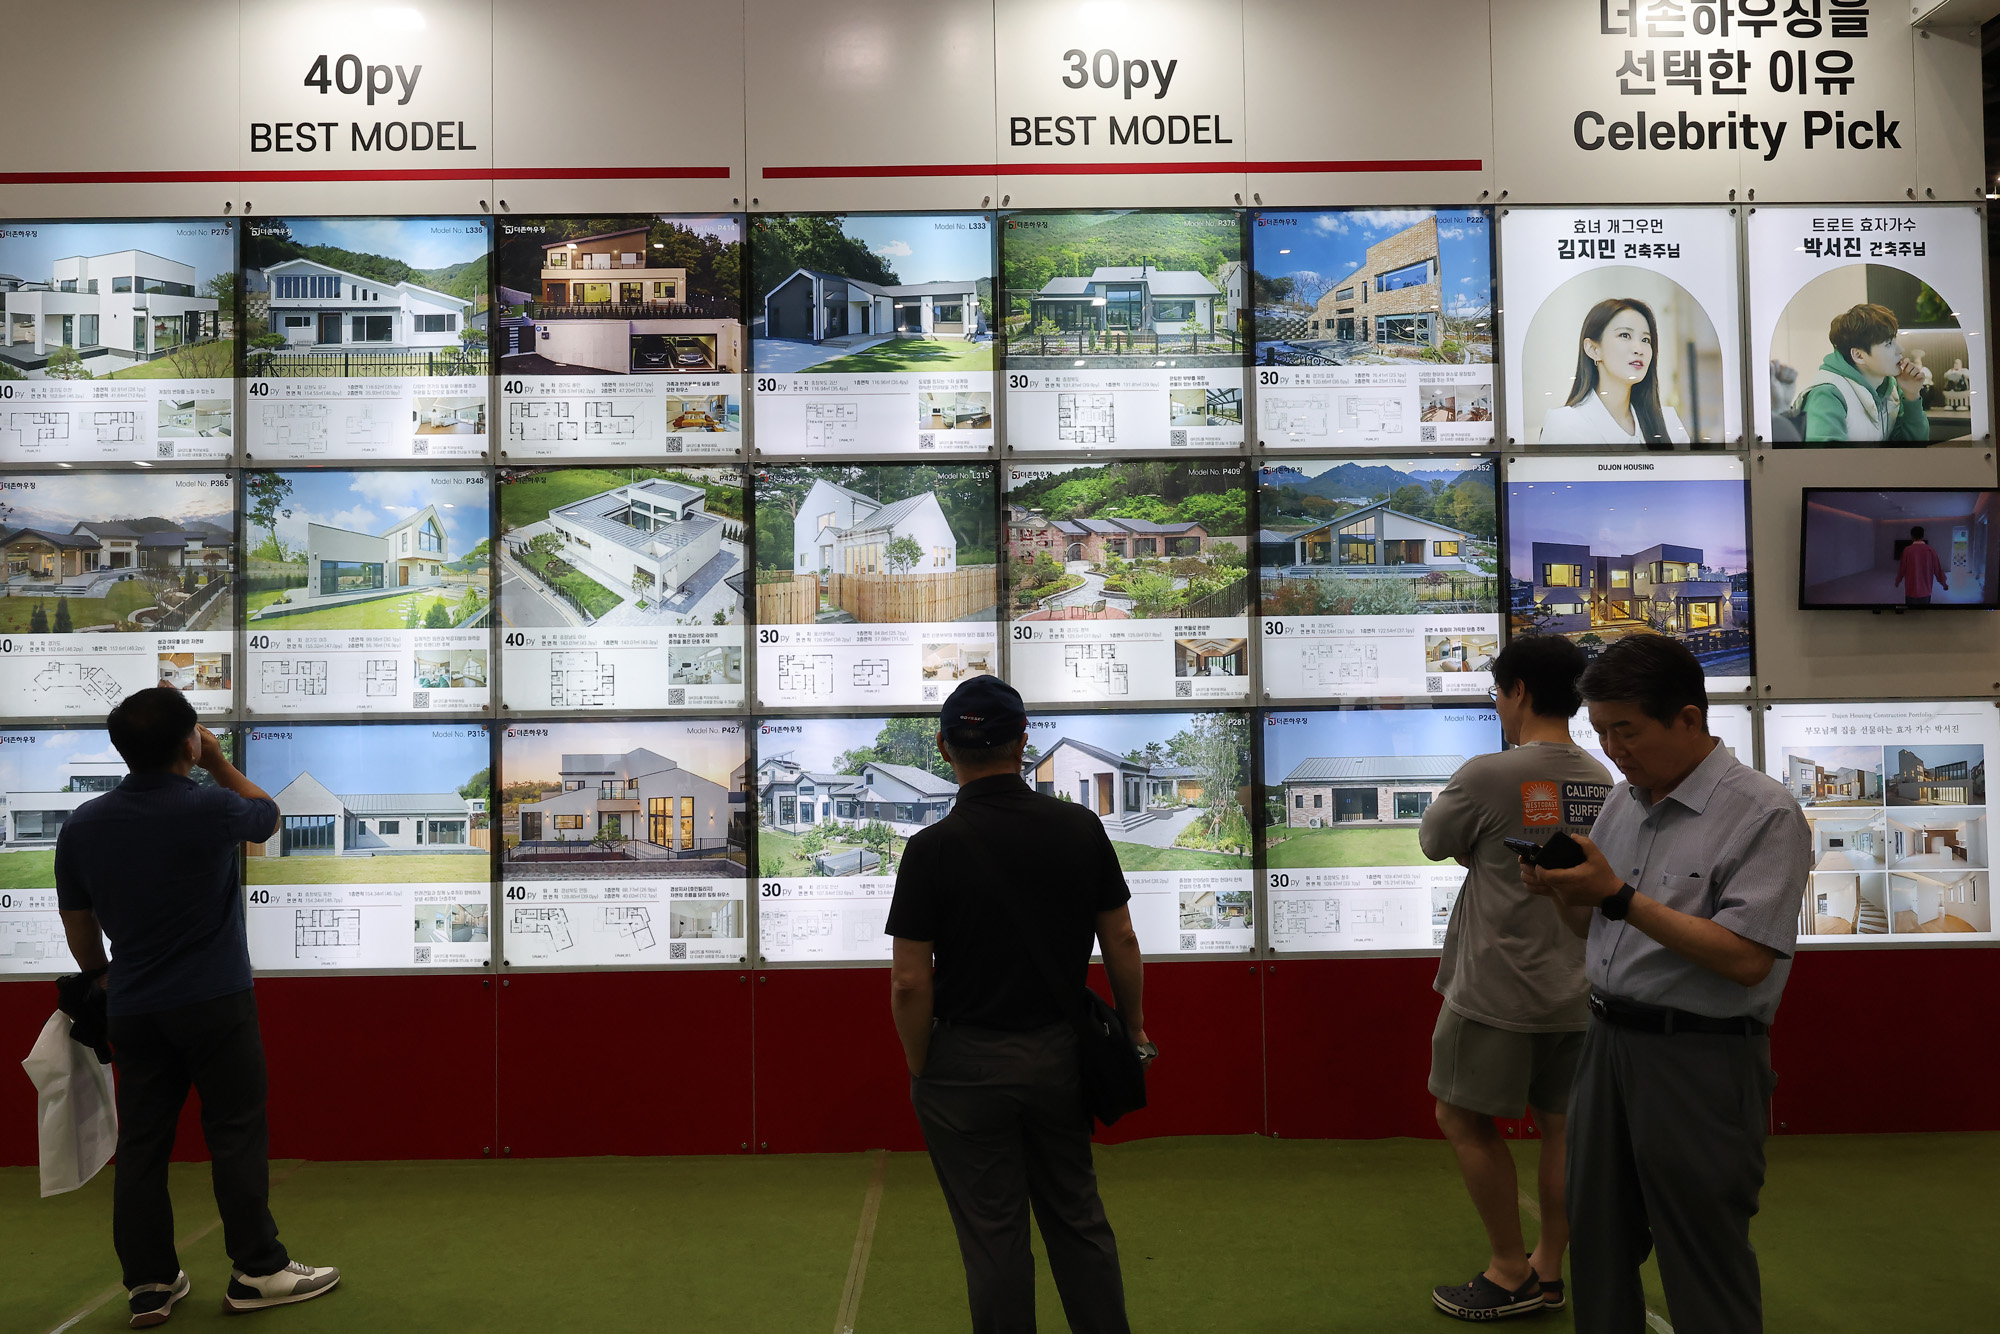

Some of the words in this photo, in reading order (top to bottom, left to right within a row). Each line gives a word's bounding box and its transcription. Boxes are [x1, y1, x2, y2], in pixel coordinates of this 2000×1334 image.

[1062, 49, 1178, 100] 30py
[1615, 48, 1751, 96] 선택한
[1769, 48, 1855, 96] 이유
[304, 54, 422, 105] 40py
[250, 122, 339, 153] BEST
[351, 121, 477, 152] MODEL
[1010, 116, 1097, 146] BEST
[1109, 115, 1233, 145] MODEL
[1573, 110, 1788, 161] Celebrity
[1803, 109, 1902, 150] Pick
[968, 222, 986, 230] L333
[1466, 216, 1484, 224] P222
[1573, 218, 1601, 235] 효녀
[1607, 217, 1664, 234] 개그우먼
[1811, 217, 1855, 233] 트로트
[1860, 216, 1917, 233] 효자가수
[1557, 238, 1616, 260] 김지민
[1623, 241, 1681, 260] 건축주님
[1803, 236, 1862, 258] 박서진
[1869, 240, 1926, 257] 건축주님
[1472, 464, 1490, 472] P352
[1598, 463, 1622, 471] DUJON
[1623, 463, 1655, 471] HOUSING
[938, 472, 958, 480] Model
[0, 638, 24, 653] 0py
[1228, 718, 1246, 726] P281
[1478, 714, 1496, 722] P243
[1849, 712, 1873, 720] Housing
[468, 730, 486, 738] P315
[1841, 725, 1857, 735] 집을
[1860, 724, 1893, 735] 선물하는
[1896, 724, 1912, 734] 효자
[1916, 724, 1932, 734] 가수
[1934, 724, 1960, 734] 박서진
[1566, 785, 1613, 798] CALIFORN
[1458, 1307, 1499, 1319] crocs
